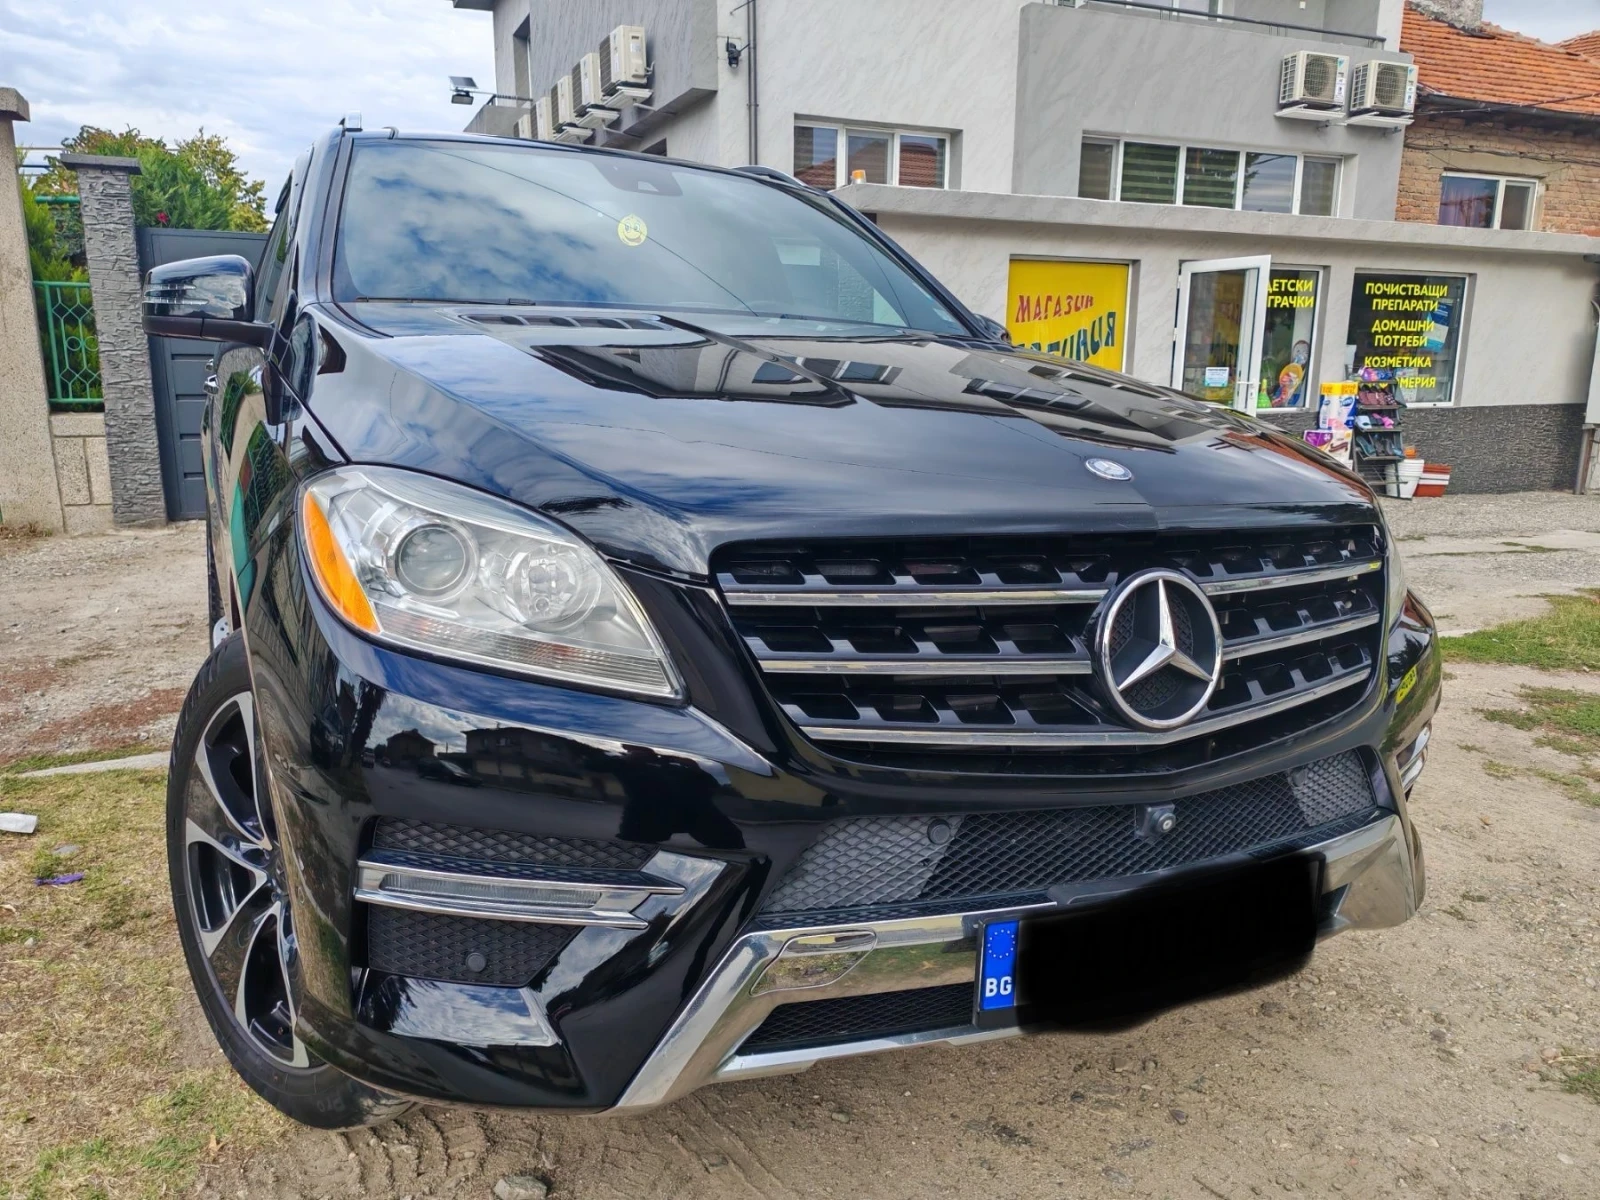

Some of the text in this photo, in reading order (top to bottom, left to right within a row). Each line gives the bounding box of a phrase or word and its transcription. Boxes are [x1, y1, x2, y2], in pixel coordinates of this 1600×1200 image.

[1365, 282, 1448, 298] ПОЧИСТВАЩИ
[1267, 295, 1314, 308] ГРАЧКИ
[1372, 298, 1438, 311] ПРЕПАРАТИ
[1015, 294, 1094, 323] МАГАЗИН
[1371, 319, 1434, 333] ДОМАШНИ
[1375, 335, 1427, 347] ПОТРЕБИ
[1364, 356, 1432, 368] КОЗМЕТИКА
[1397, 376, 1436, 389] МЕРИЯ
[985, 976, 1012, 997] BG
